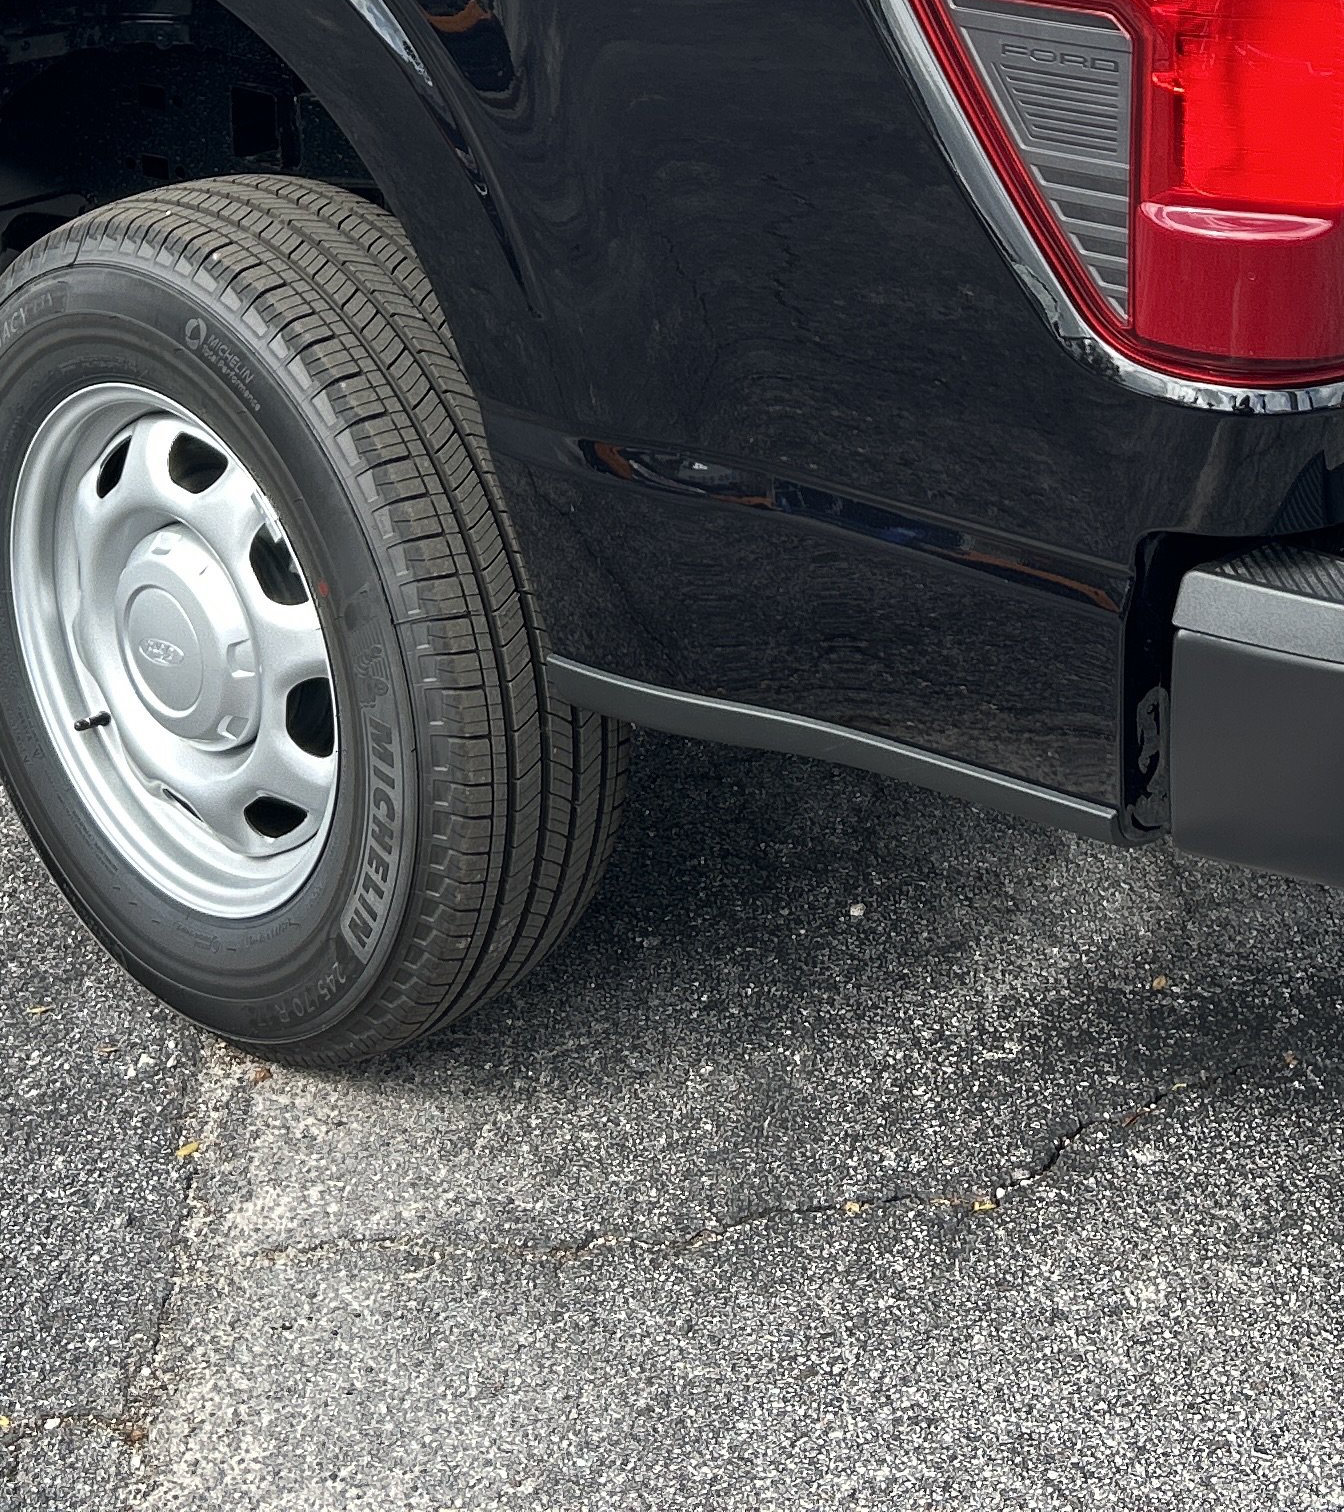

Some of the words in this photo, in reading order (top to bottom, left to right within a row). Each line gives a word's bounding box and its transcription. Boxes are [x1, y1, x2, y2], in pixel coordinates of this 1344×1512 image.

[1001, 43, 1120, 73] FORD
[207, 335, 255, 384] MICHELIN
[346, 714, 397, 950] MICHELIN
